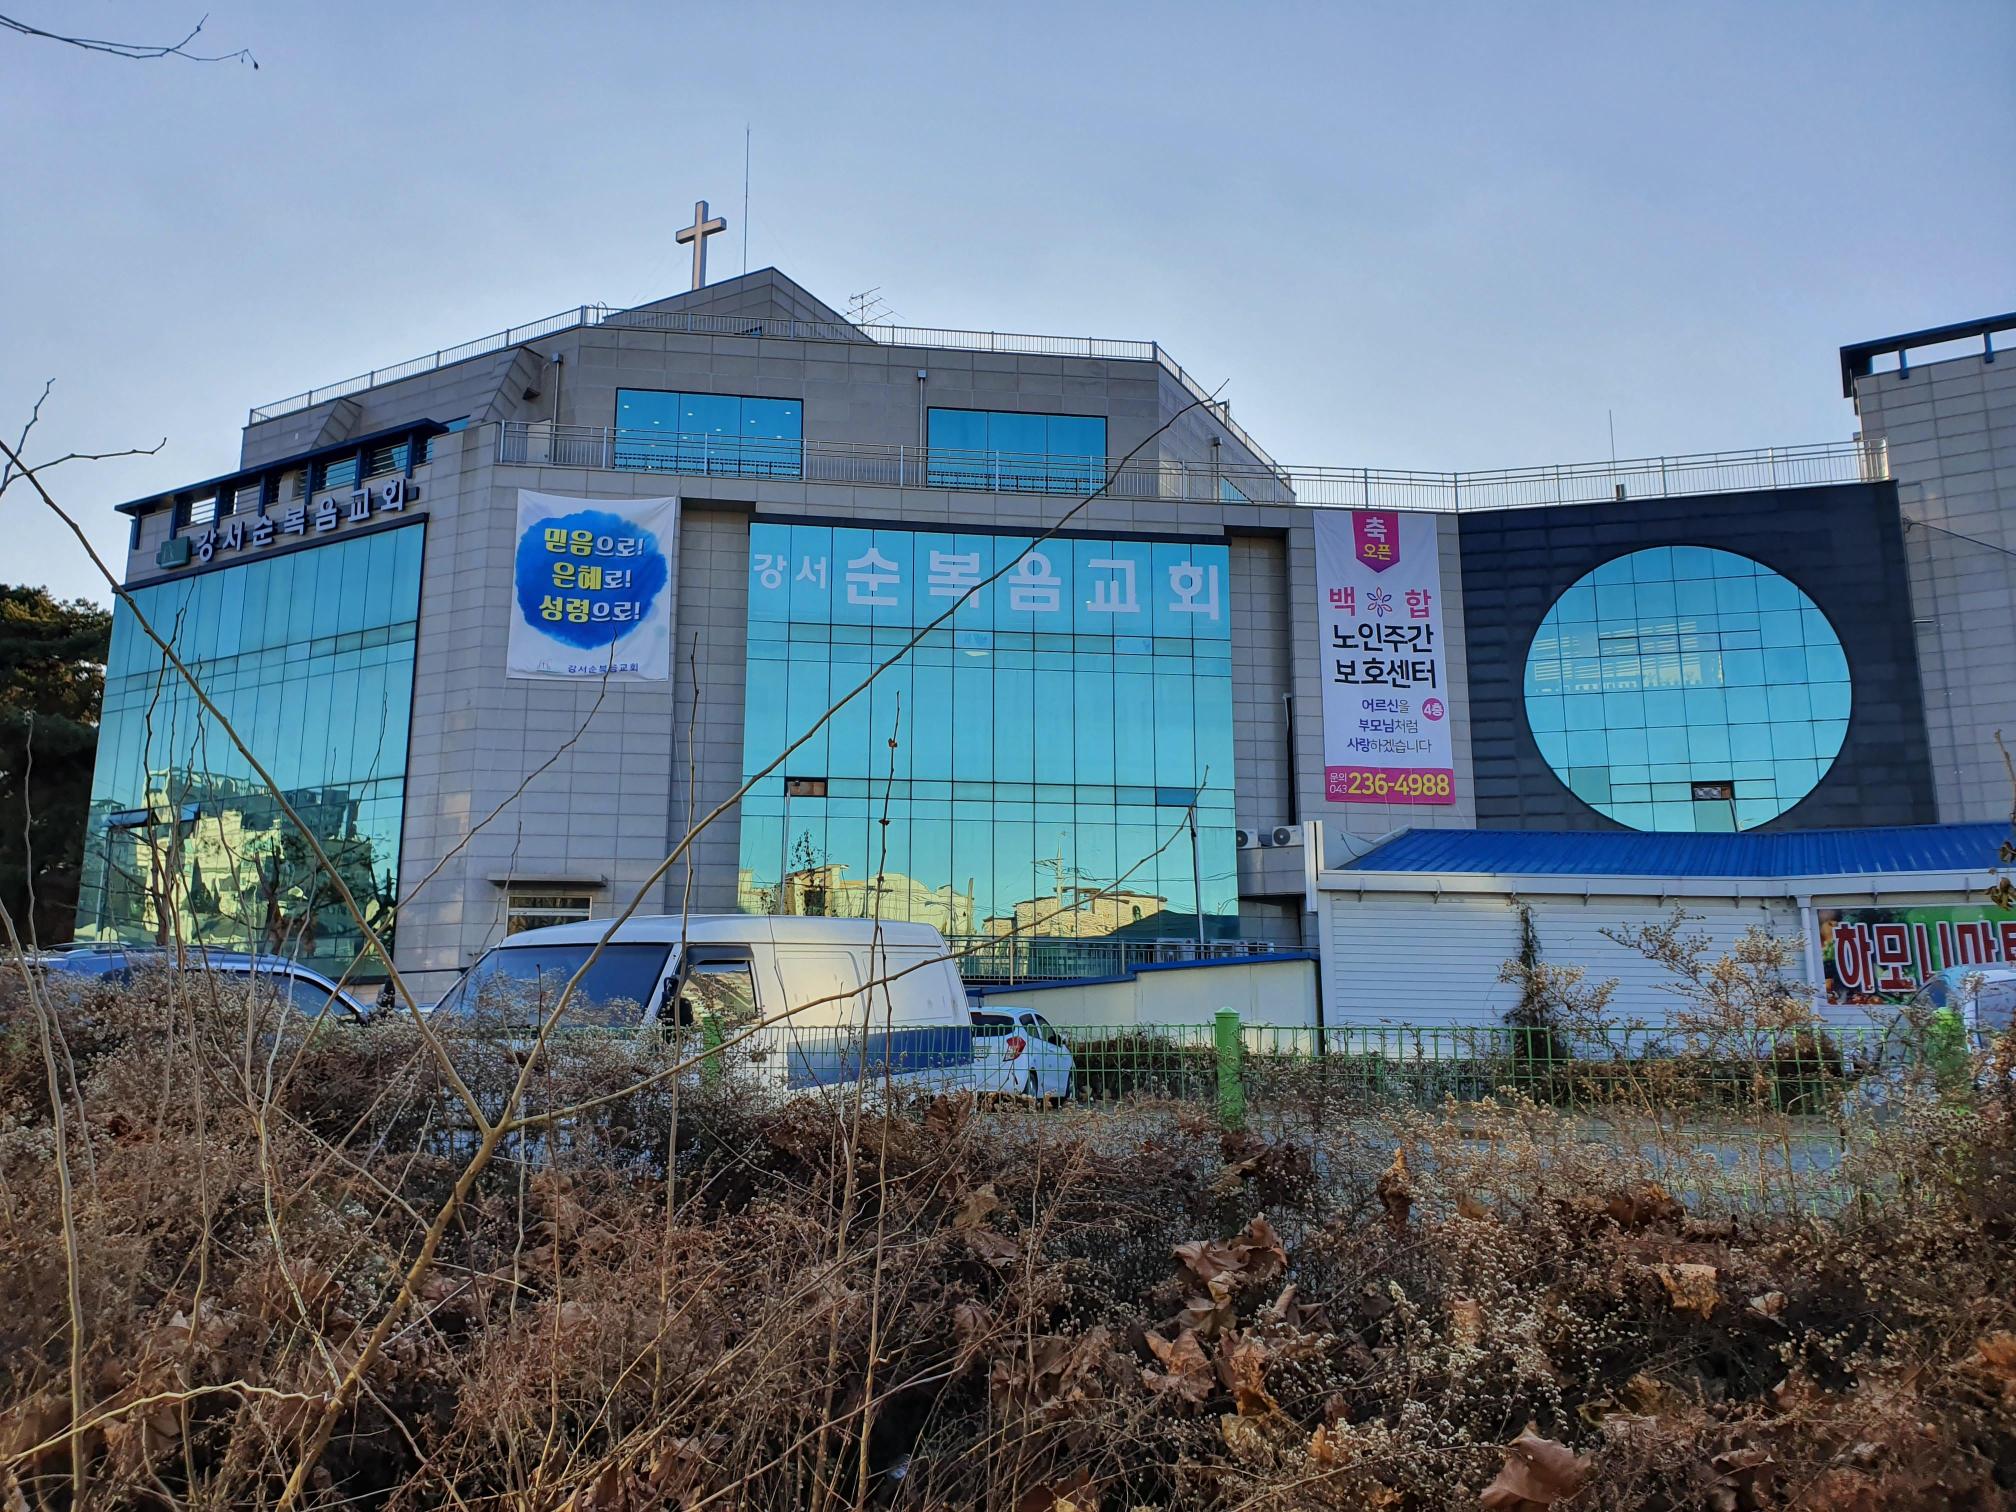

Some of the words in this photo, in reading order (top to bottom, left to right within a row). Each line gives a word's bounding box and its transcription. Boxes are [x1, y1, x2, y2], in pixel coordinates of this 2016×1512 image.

[195, 478, 406, 563] 강서순복음교회
[1363, 516, 1388, 543] 축
[544, 527, 645, 557] 믿음으로!
[1363, 543, 1392, 561] 오픈
[551, 561, 632, 590] 은혜로!
[845, 547, 1220, 621] 순복음교회
[538, 594, 641, 623] 성령으로!
[1332, 622, 1434, 653] 노인주간
[1334, 657, 1437, 689] 보호센터
[1361, 698, 1411, 714] 어르신을
[1422, 702, 1444, 717] 4층
[1358, 718, 1419, 734] 부모님처럼
[1346, 738, 1433, 754] 사랑하겠습니다
[1329, 772, 1347, 783] 문의
[1329, 784, 1347, 794] 043
[1348, 771, 1450, 796] 236-4988
[1833, 920, 2016, 993] 하모니마
